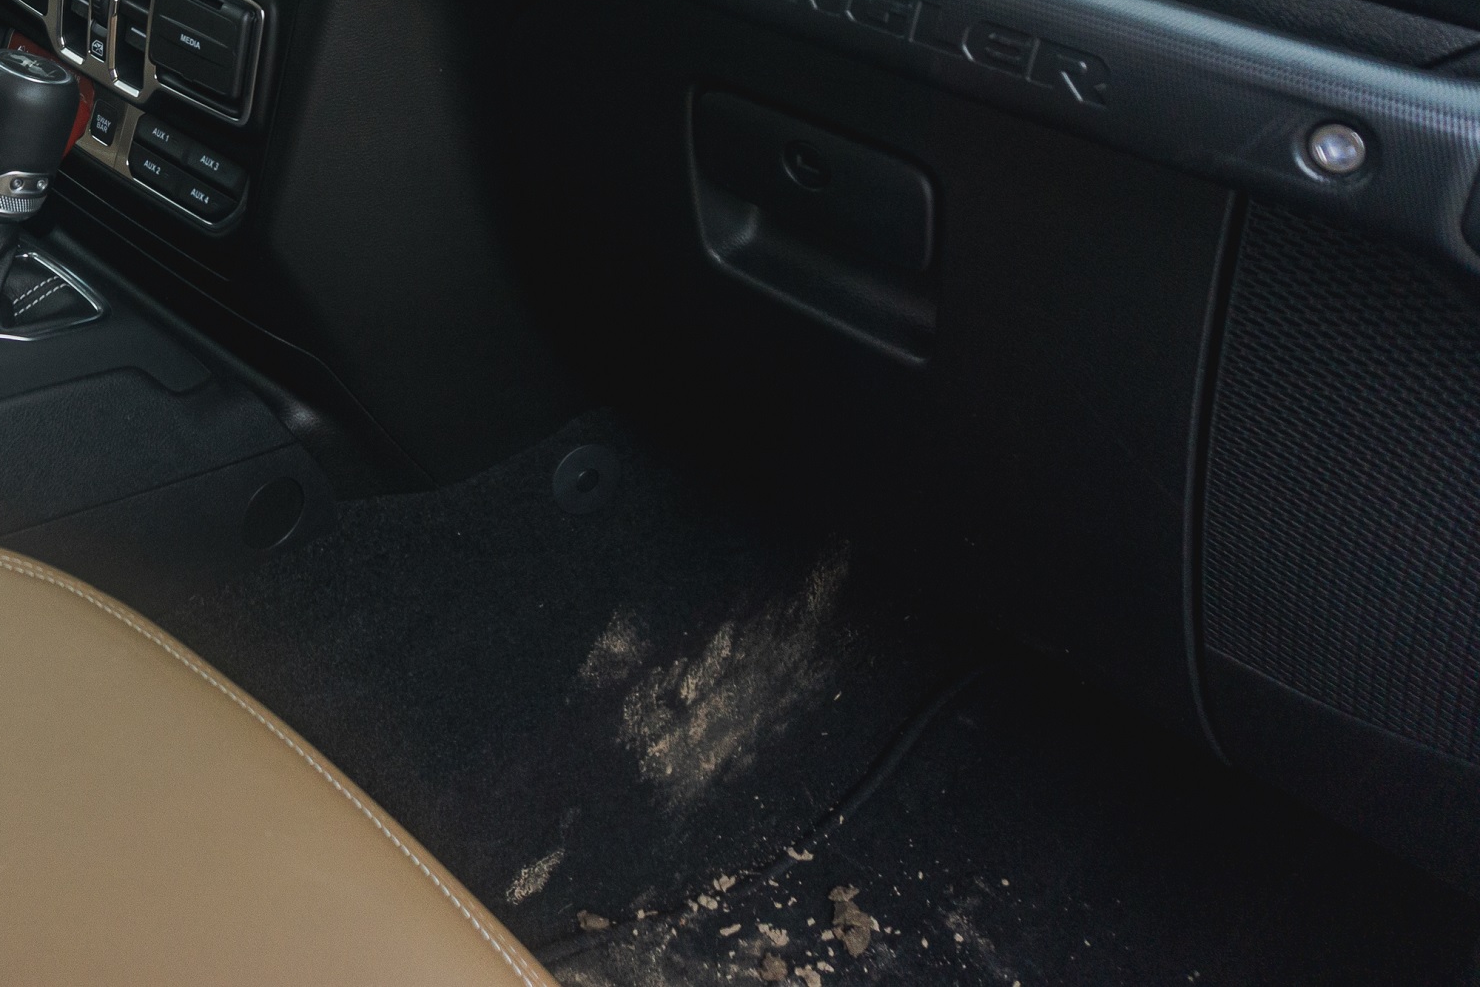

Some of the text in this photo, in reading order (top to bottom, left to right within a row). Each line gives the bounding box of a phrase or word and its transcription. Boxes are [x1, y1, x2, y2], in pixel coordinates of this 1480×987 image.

[179, 33, 201, 51] MEDIA
[96, 114, 112, 128] SWAY
[96, 123, 108, 134] BAR
[151, 127, 170, 142] AUX 1
[143, 159, 162, 175] AUX 2
[199, 155, 220, 171] AUX 3
[190, 188, 210, 204] AUX 4
